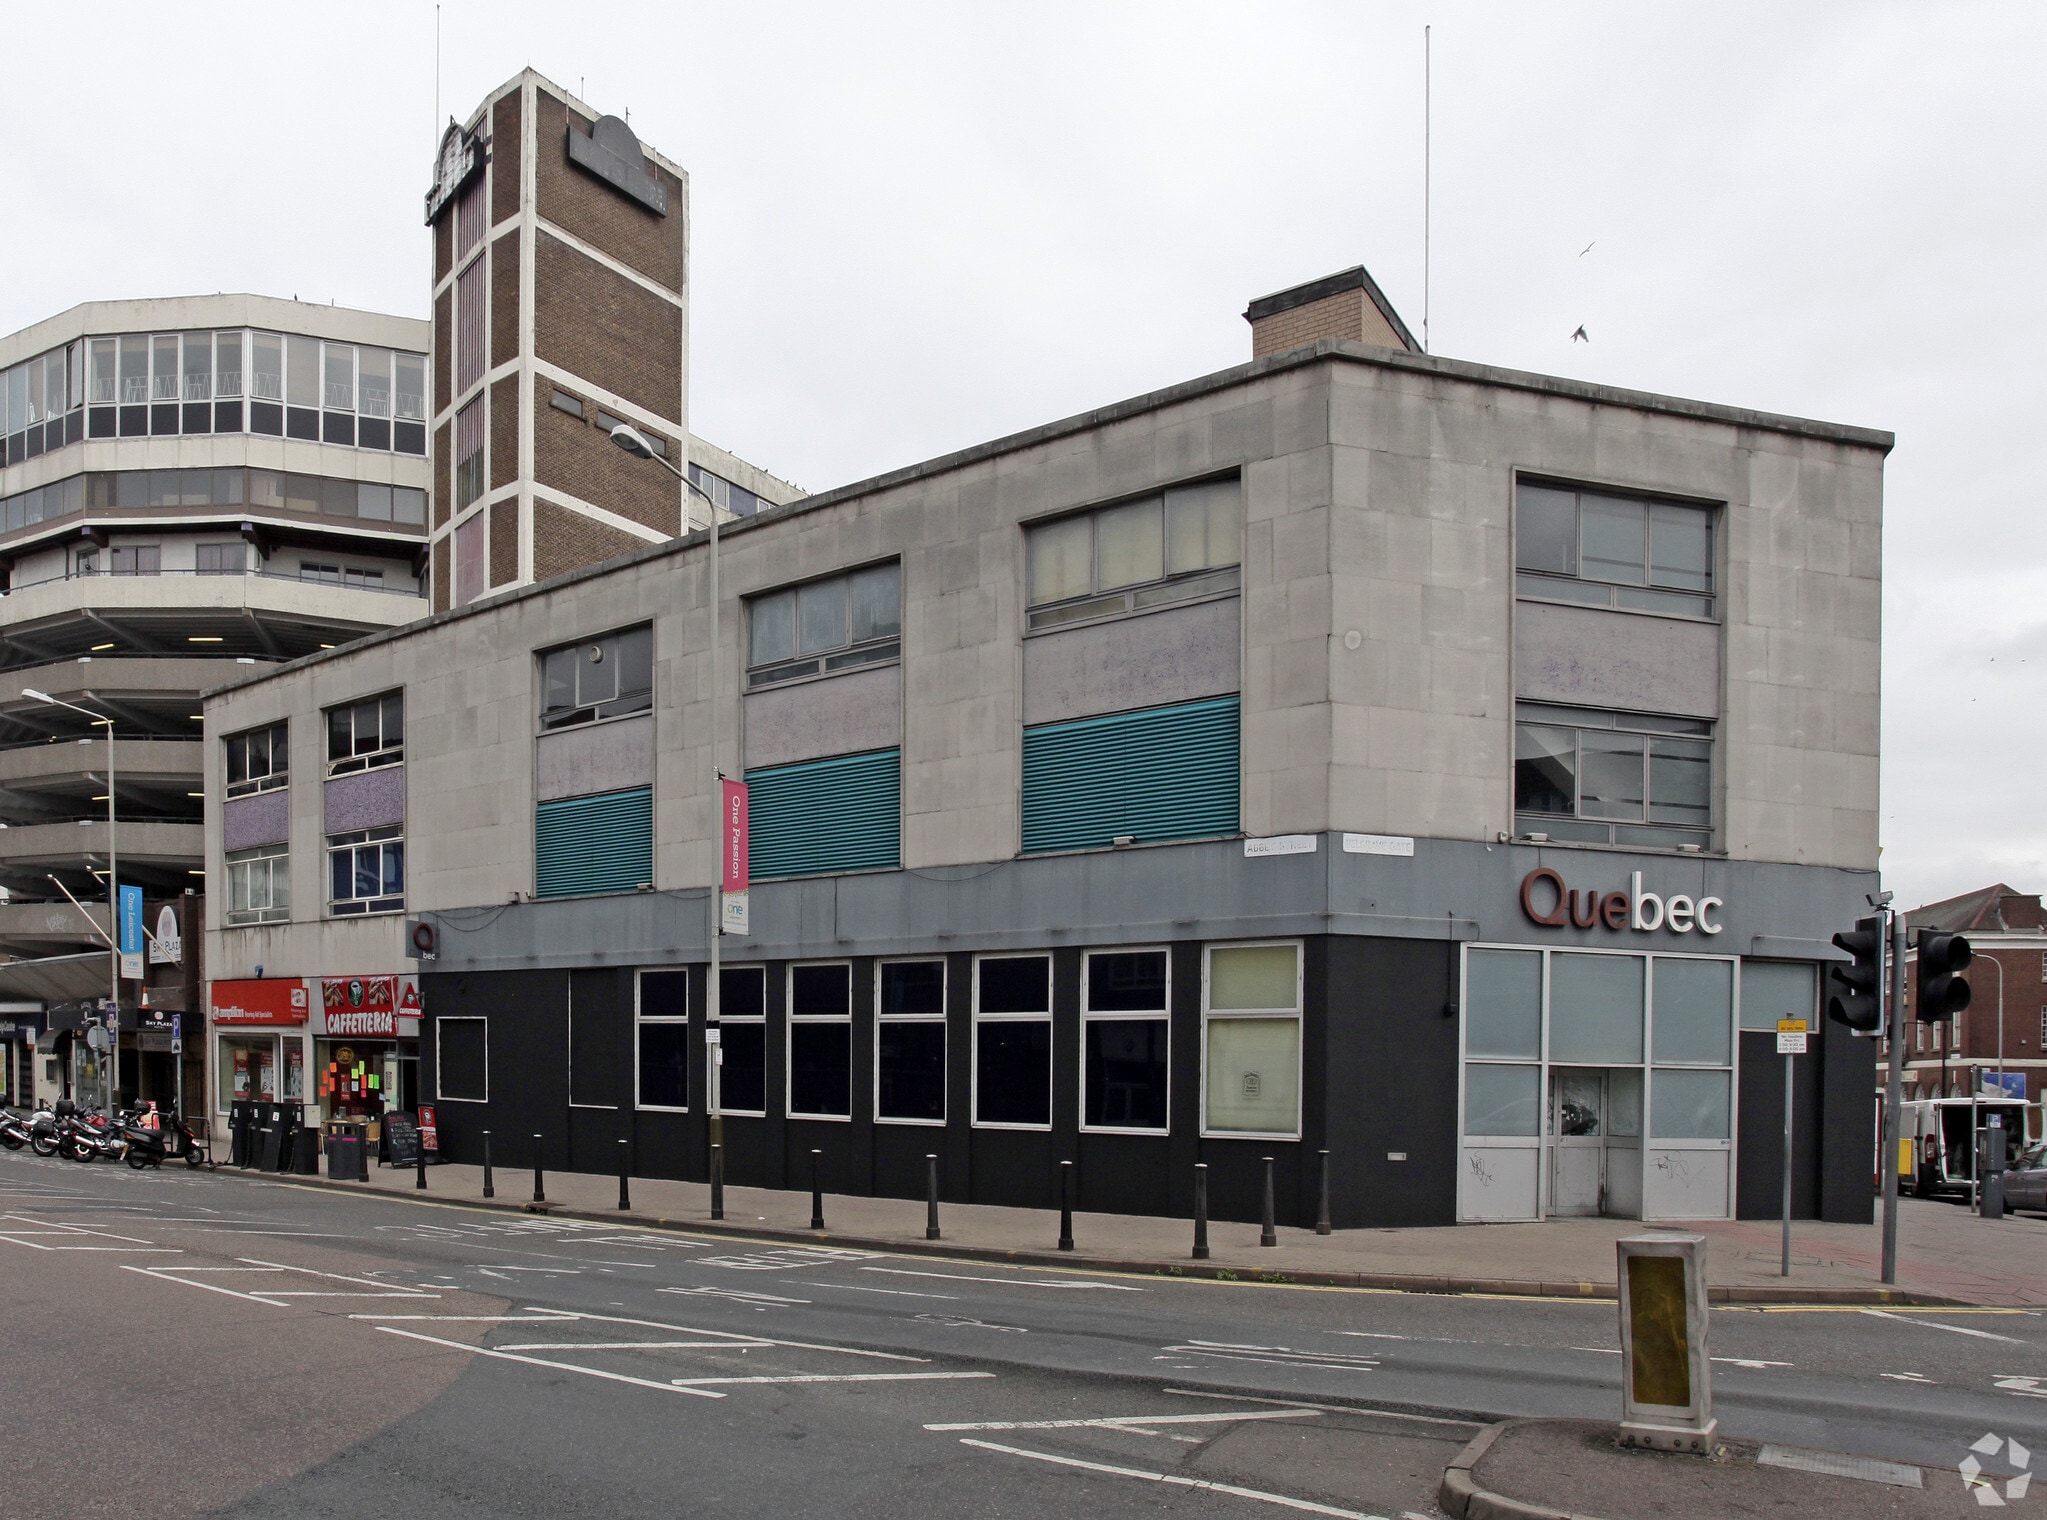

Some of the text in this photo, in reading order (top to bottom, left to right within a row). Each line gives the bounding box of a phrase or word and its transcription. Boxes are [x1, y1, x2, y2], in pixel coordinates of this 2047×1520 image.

[732, 795, 741, 879] One Passion
[1247, 841, 1274, 853] ABBE
[128, 892, 136, 911] One
[1520, 867, 1723, 935] Quebec
[156, 1020, 173, 1028] PLAZA
[173, 1017, 179, 1037] P
[327, 1011, 393, 1034] CAFFETTERIA
